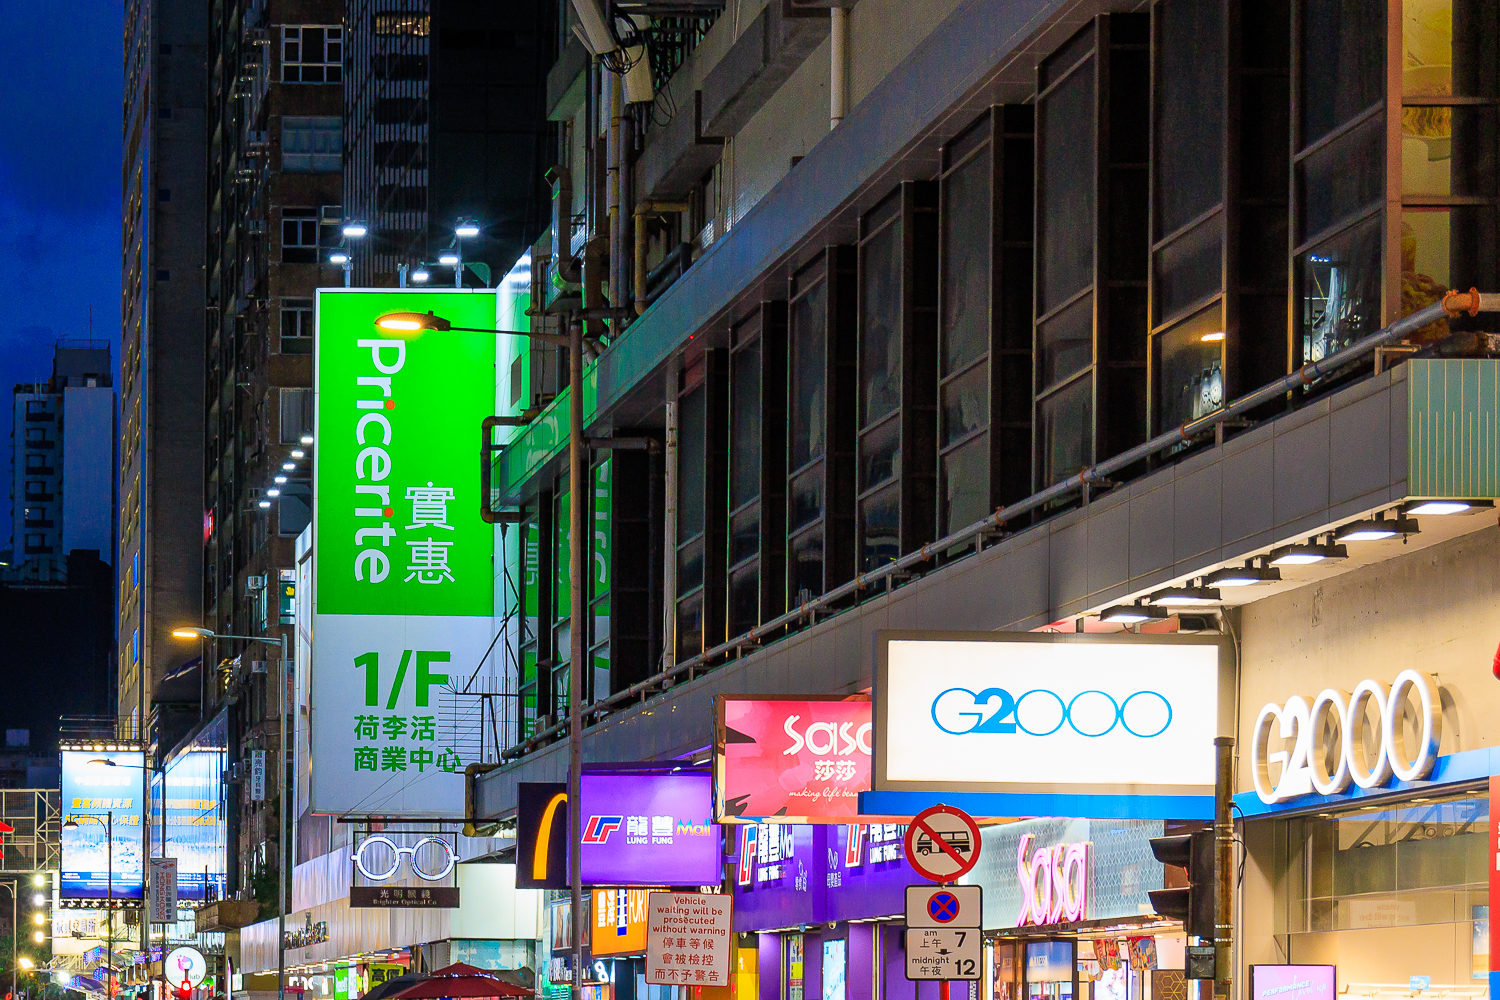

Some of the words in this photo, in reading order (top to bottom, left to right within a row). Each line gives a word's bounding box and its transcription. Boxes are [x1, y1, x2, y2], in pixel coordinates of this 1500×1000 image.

[354, 338, 406, 584] Pricerite
[404, 480, 456, 585] 實惠
[353, 650, 451, 710] 1/F
[931, 687, 1172, 737] G2000
[354, 715, 436, 741] 荷李活
[1252, 669, 1442, 804] G2000
[354, 746, 461, 772] 商業中心
[815, 760, 856, 782] 莎莎
[789, 790, 819, 801] making
[823, 788, 840, 801] life
[676, 818, 711, 836] Mall
[380, 889, 431, 899] 光明眼鏡
[674, 896, 706, 905] Vehicle
[657, 906, 689, 916] waiting
[712, 907, 722, 915] be
[663, 916, 715, 925] prosecuted
[690, 927, 726, 936] warning
[663, 937, 714, 950] 停車等候
[920, 938, 942, 948] 上午
[955, 932, 967, 947] 7
[662, 952, 714, 966] 會被檢控
[912, 957, 949, 966] midnight
[955, 959, 976, 976] 12
[655, 968, 719, 982] 而不予警告
[920, 966, 942, 976] 午夜
[1262, 980, 1310, 998] PERFORMANCE
